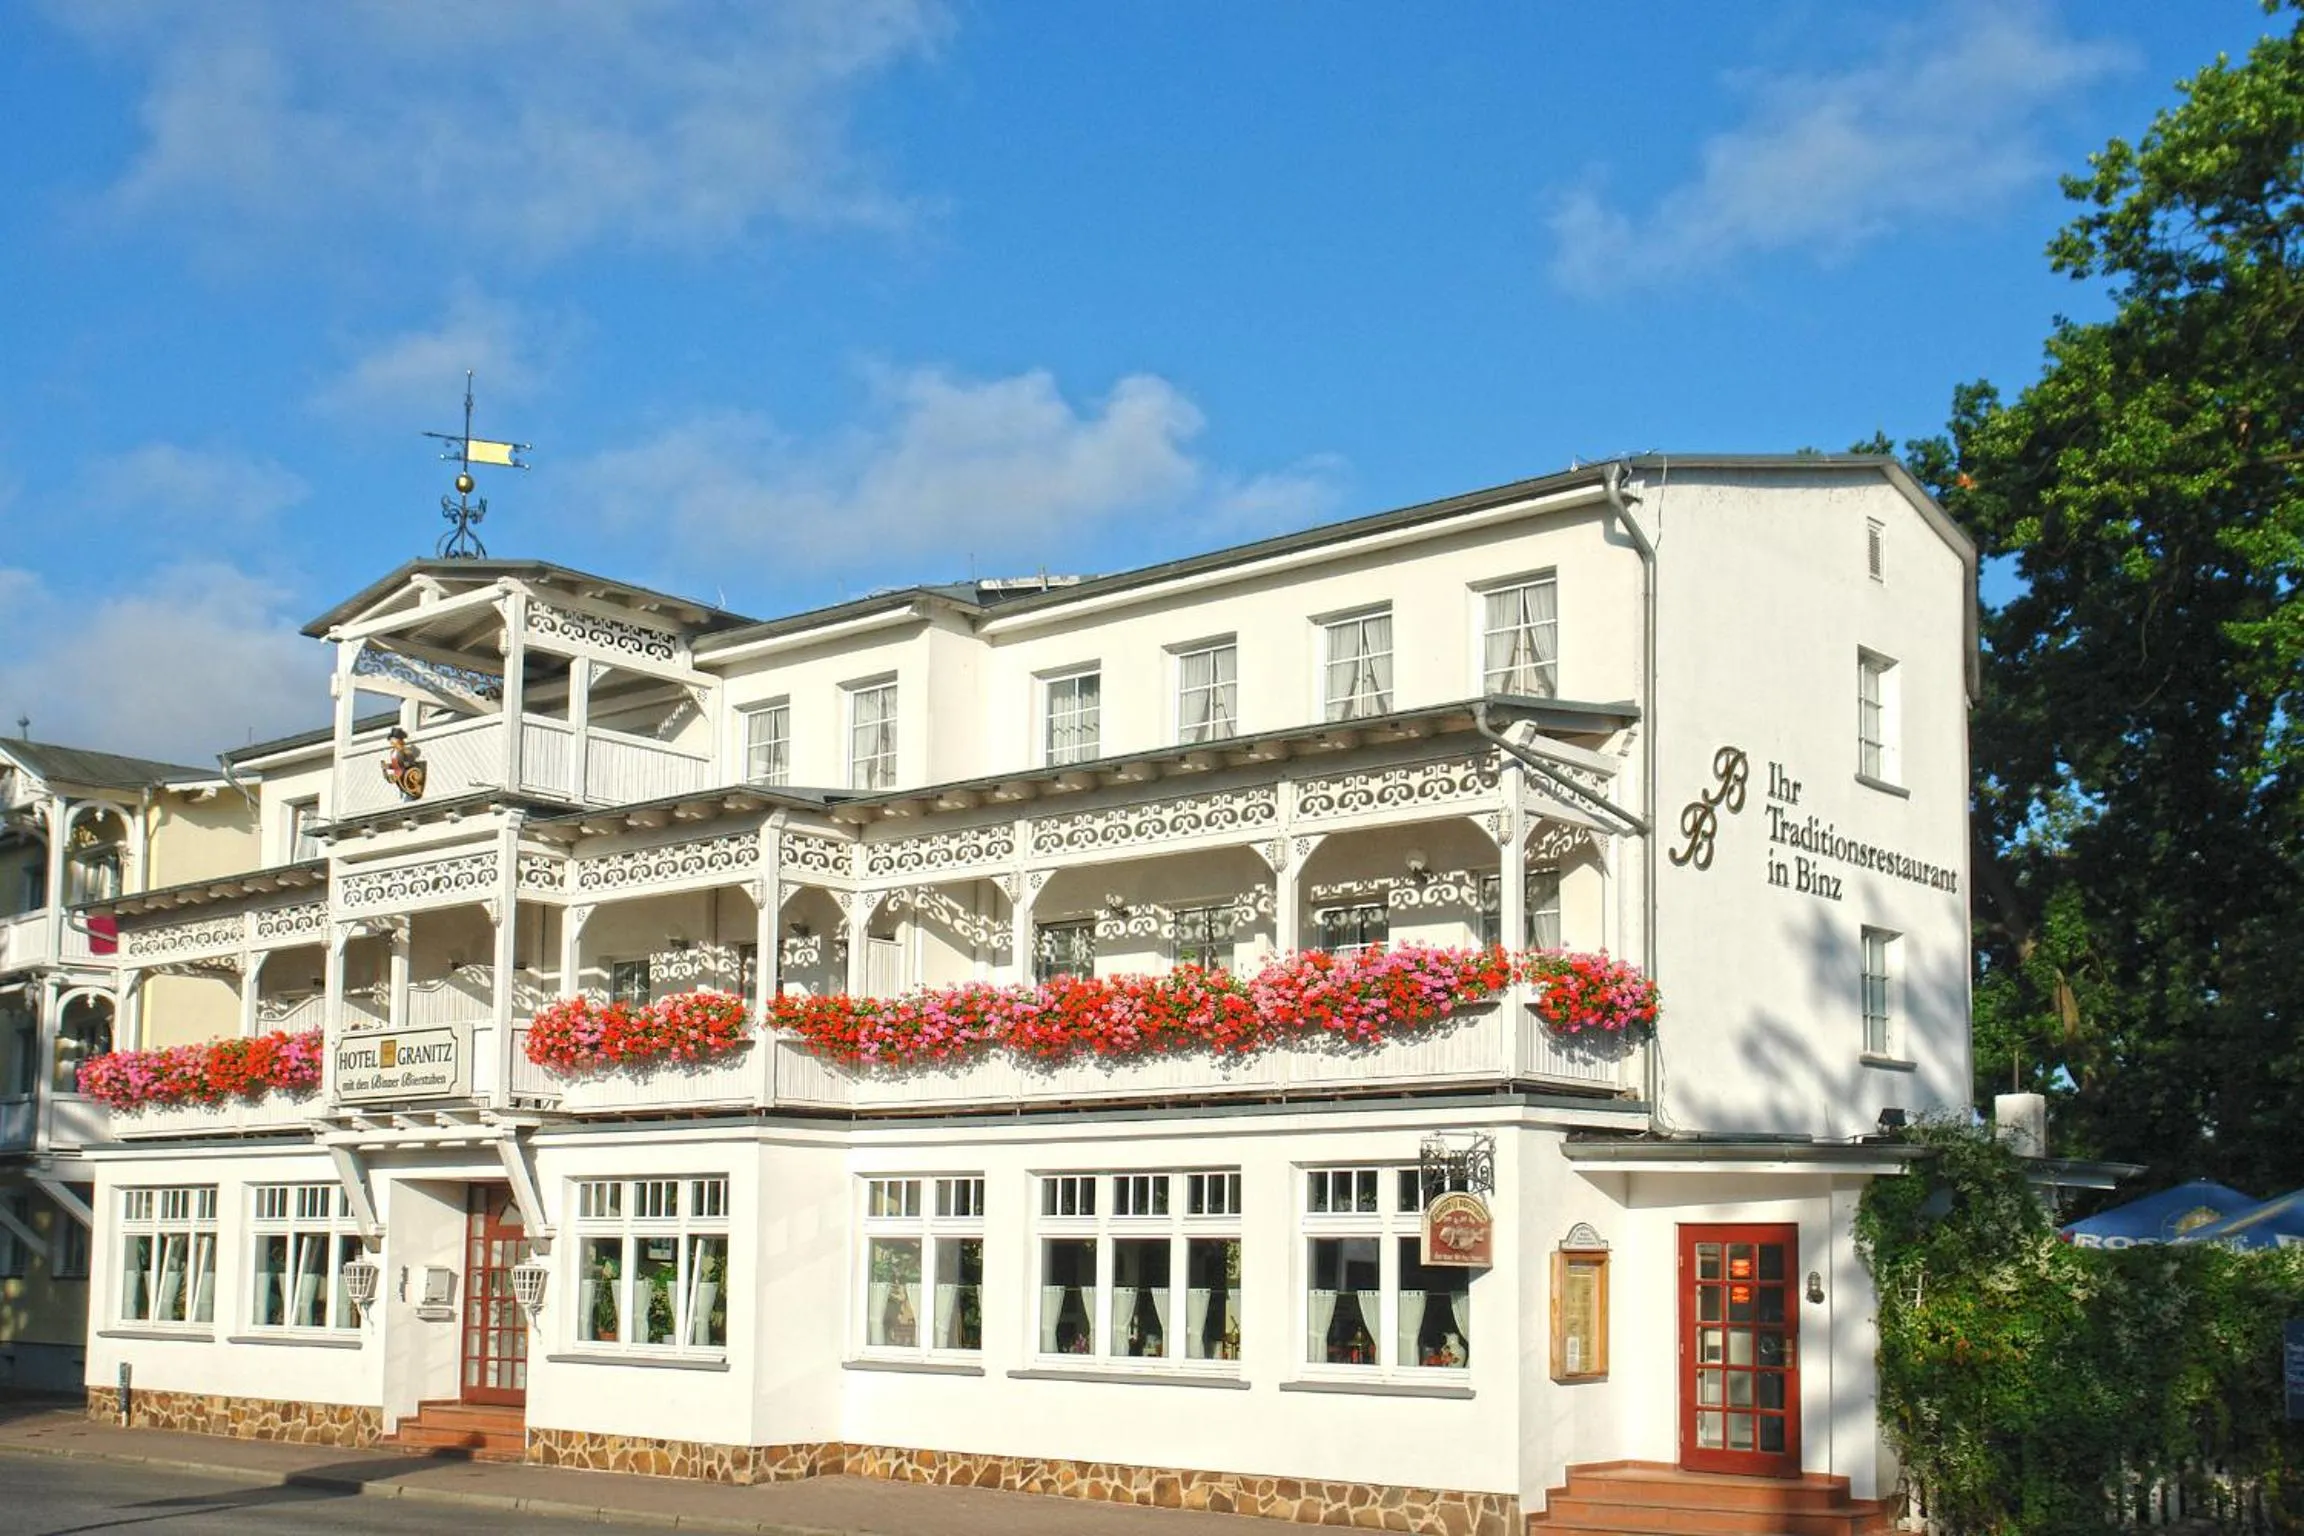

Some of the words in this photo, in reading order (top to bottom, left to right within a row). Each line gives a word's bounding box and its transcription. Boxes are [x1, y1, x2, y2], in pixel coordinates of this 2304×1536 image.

[1768, 761, 1802, 805] Ihr
[1765, 804, 1958, 894] Traditionsrestaurant
[1767, 848, 1789, 887] in
[1795, 855, 1842, 901] Binz
[340, 1050, 378, 1070] HOTEL
[397, 1043, 452, 1065] GRANITZ
